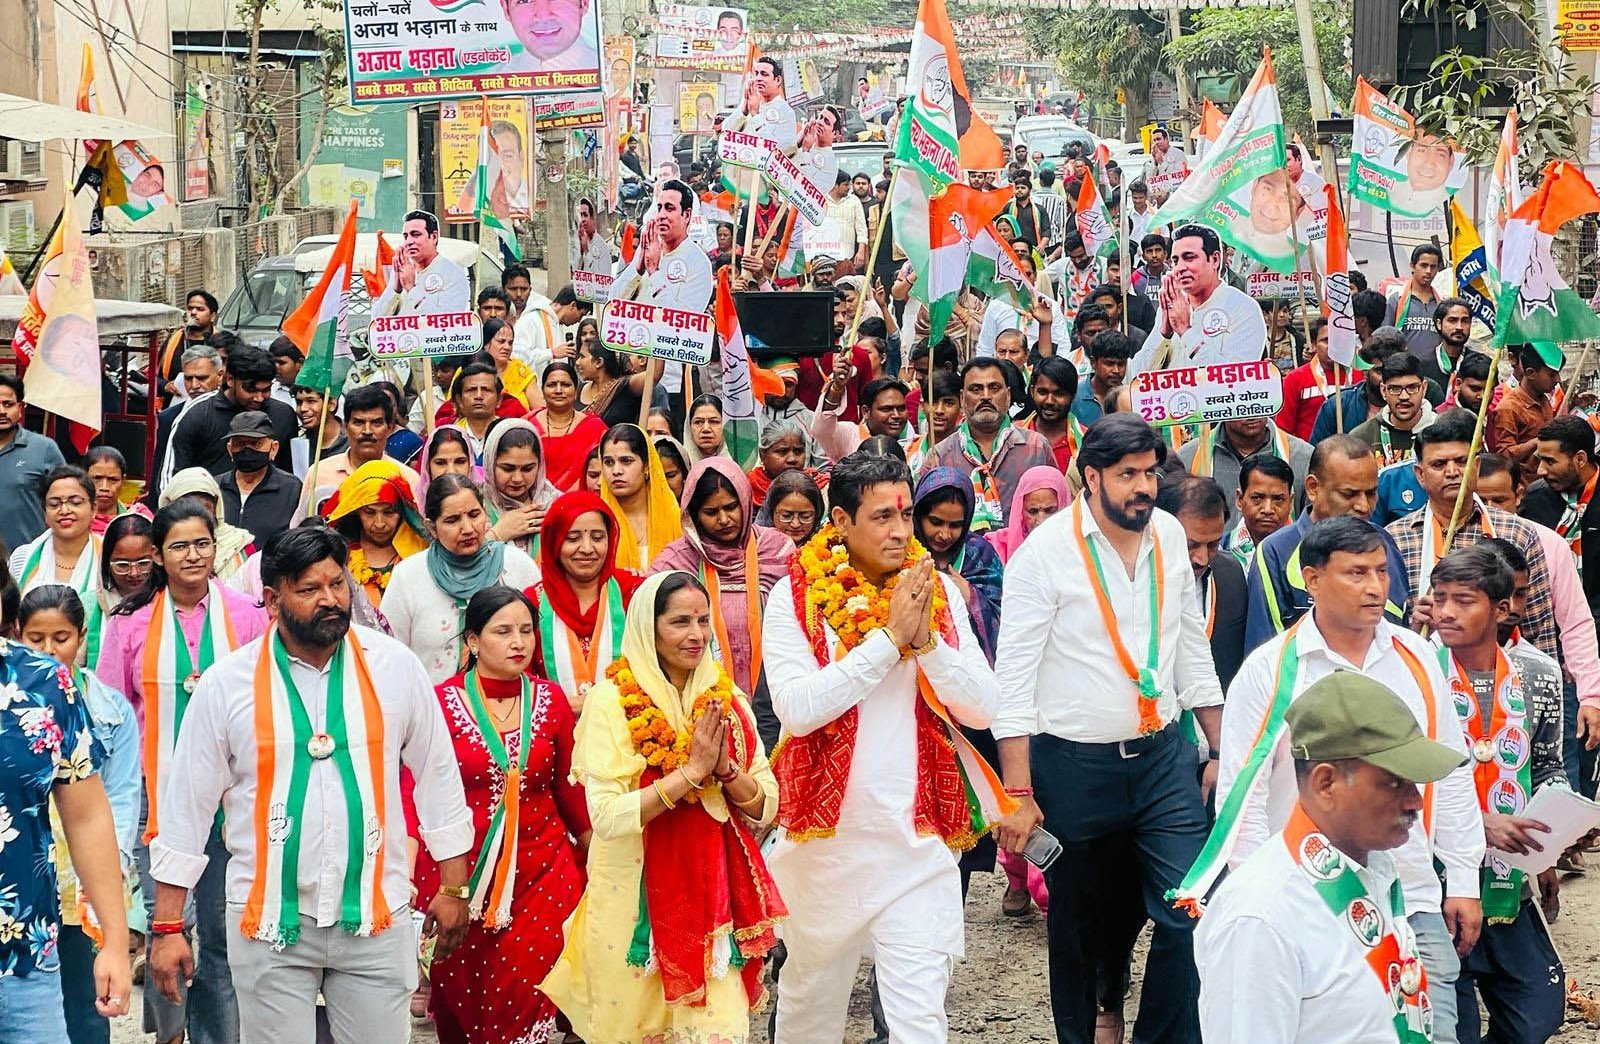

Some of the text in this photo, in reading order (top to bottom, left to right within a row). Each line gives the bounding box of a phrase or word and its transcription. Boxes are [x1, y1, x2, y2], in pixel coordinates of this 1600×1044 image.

[354, 19, 497, 40] अजय भड़ाना के साथ
[358, 51, 401, 73] अजय
[408, 48, 455, 75] भड़ाना
[356, 82, 381, 97] सबसे
[413, 79, 437, 94] सबसे
[481, 74, 505, 90] सबसे
[508, 72, 532, 88] योग्य
[553, 71, 598, 86] मिलनसार
[443, 110, 458, 119] 23
[324, 136, 384, 148] HAPPINESS
[724, 130, 758, 147] अजय
[723, 150, 737, 160] 23
[767, 168, 779, 180] 23
[775, 152, 827, 208] अजय भड़ाना
[575, 270, 592, 283] अजय
[1251, 273, 1280, 283] अजय
[376, 312, 473, 332] अजय भड़ाना
[610, 299, 710, 333] अजय भड़ाना
[425, 334, 471, 344] सबसे योग्य
[606, 330, 626, 344] 23
[657, 334, 704, 350] सबसे योग्य
[377, 343, 396, 353] 23
[423, 343, 475, 354] सबसे शिक्षित
[652, 347, 705, 363] सबसे शिक्षित
[1138, 361, 1270, 393] अजय भड़ाना
[1205, 390, 1269, 406] सबसे योग्य
[1140, 405, 1167, 422] 23
[1202, 403, 1274, 420] सबसे शिक्षित
